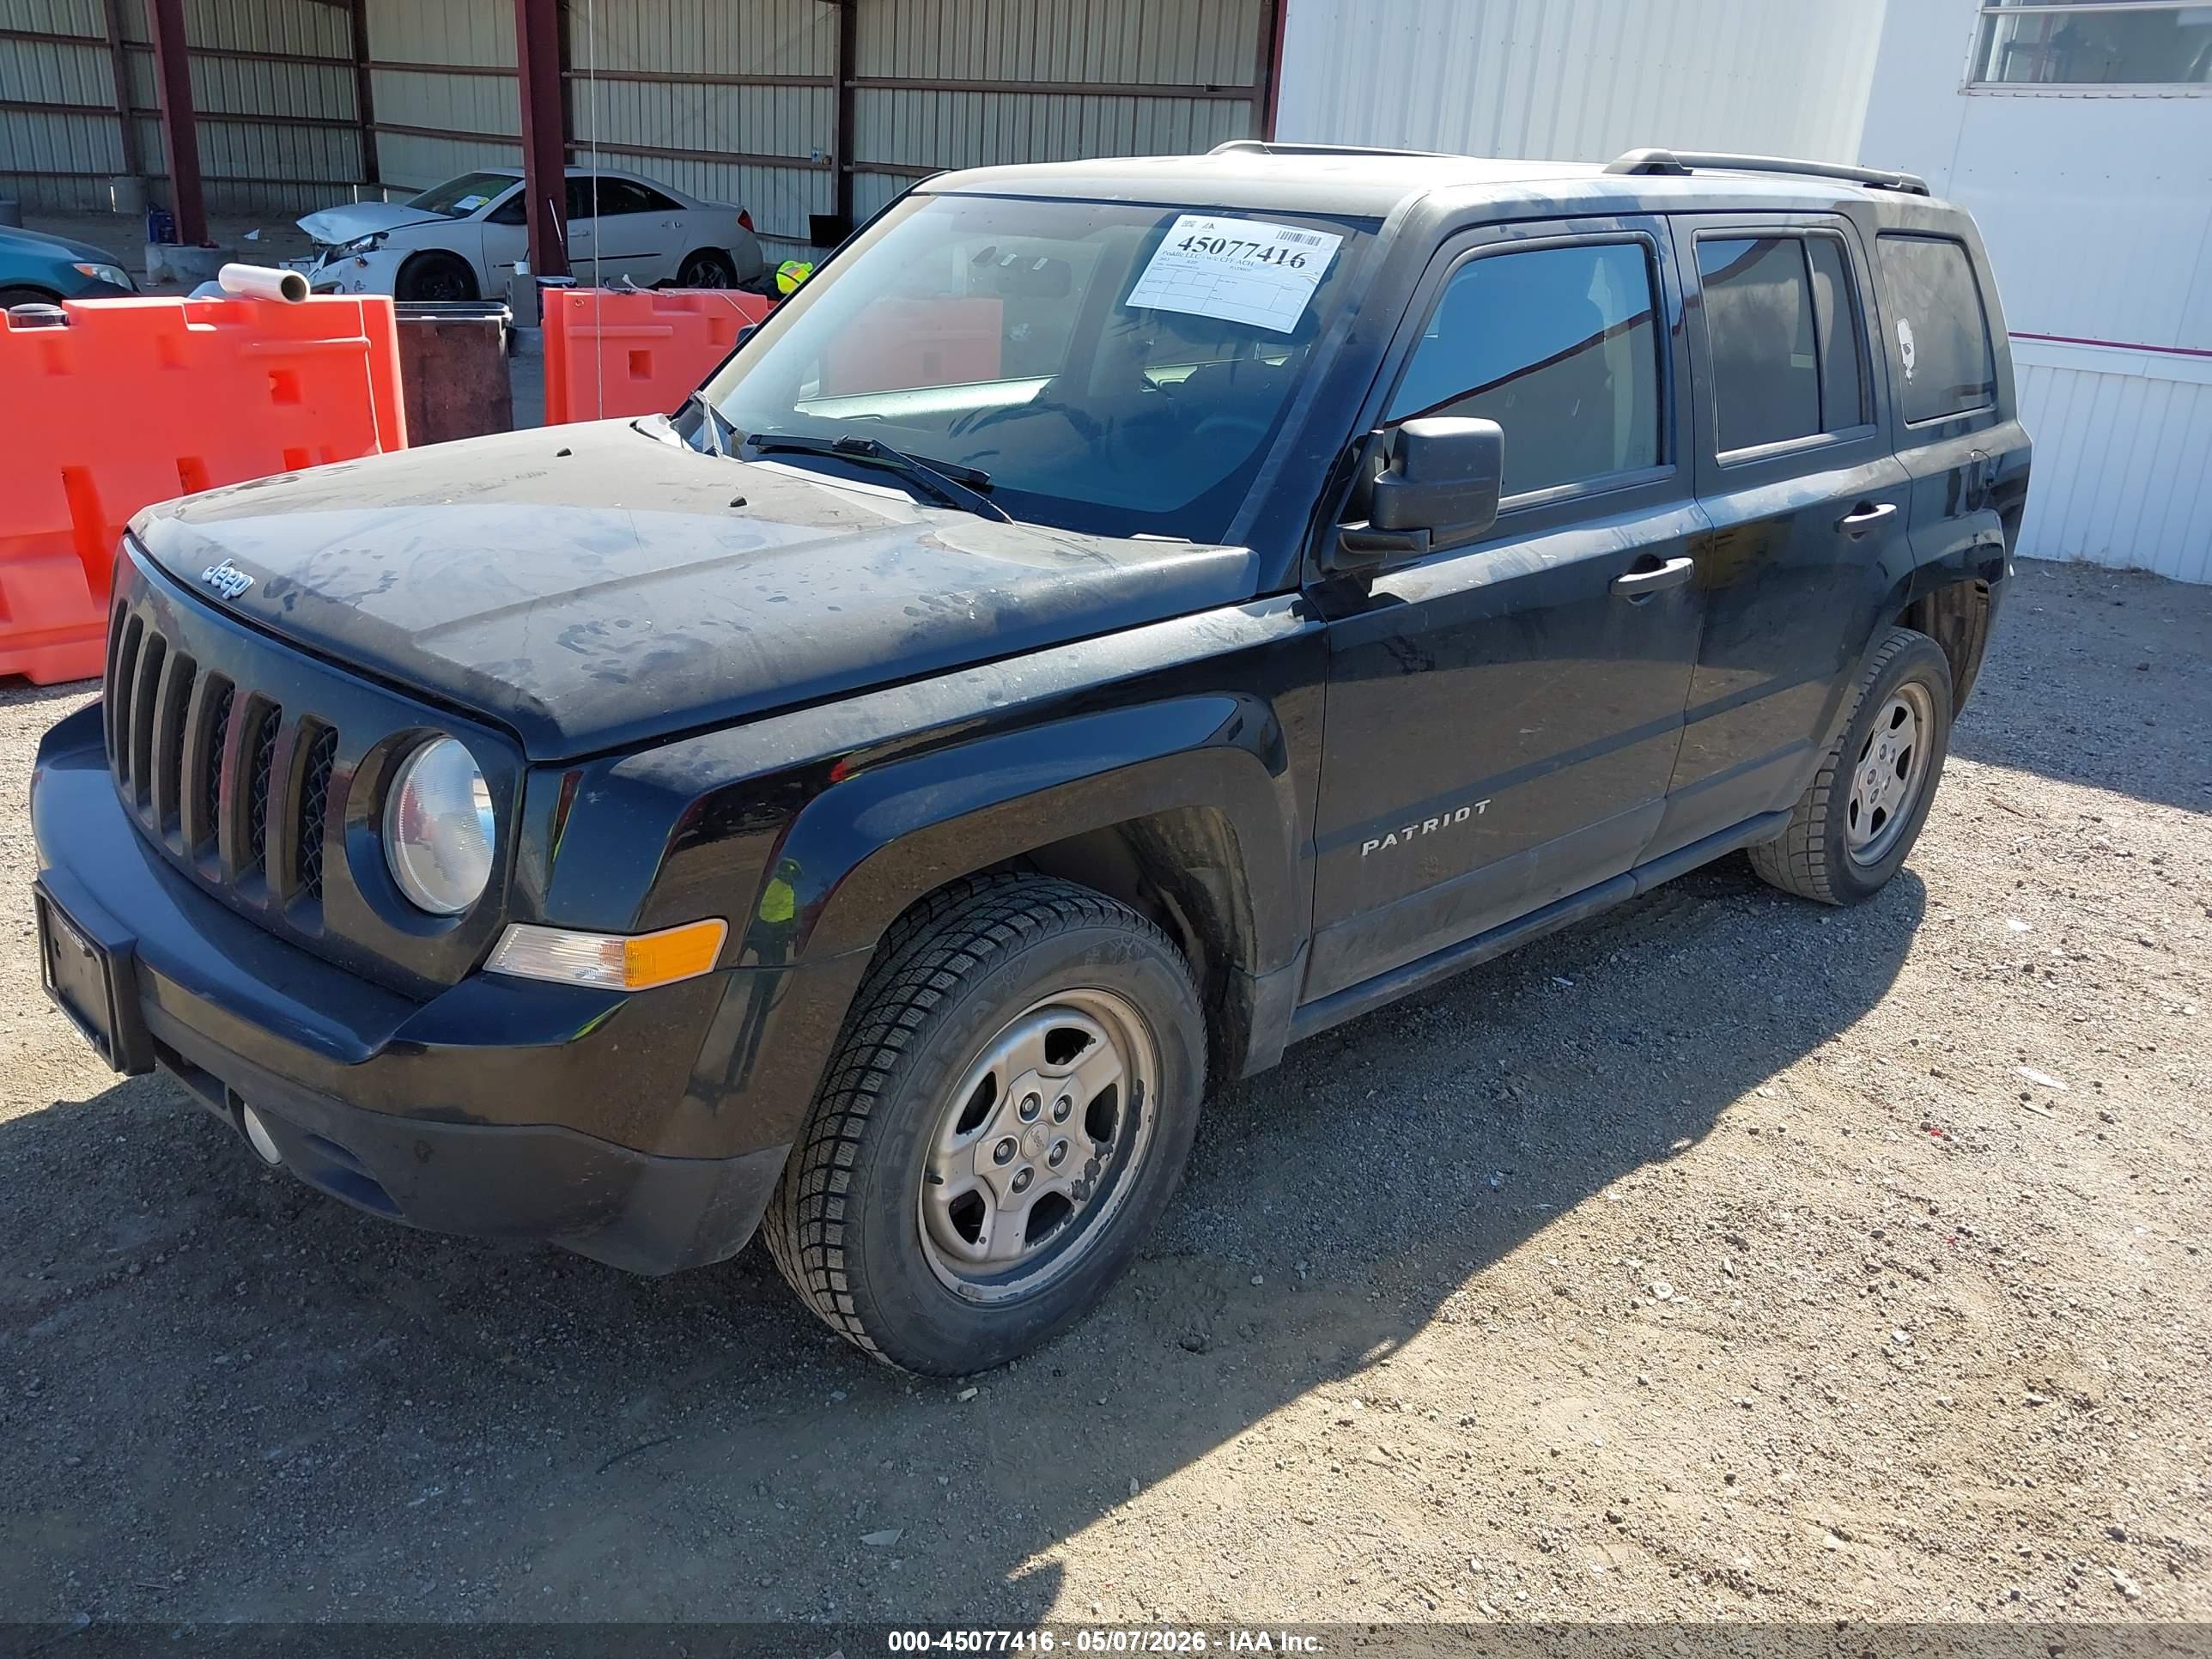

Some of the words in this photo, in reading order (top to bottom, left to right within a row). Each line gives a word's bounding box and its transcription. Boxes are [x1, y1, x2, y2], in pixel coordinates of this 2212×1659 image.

[1177, 234, 1312, 270] 45077416
[202, 558, 255, 600] Jeep
[1361, 799, 1492, 856] PATRIOT
